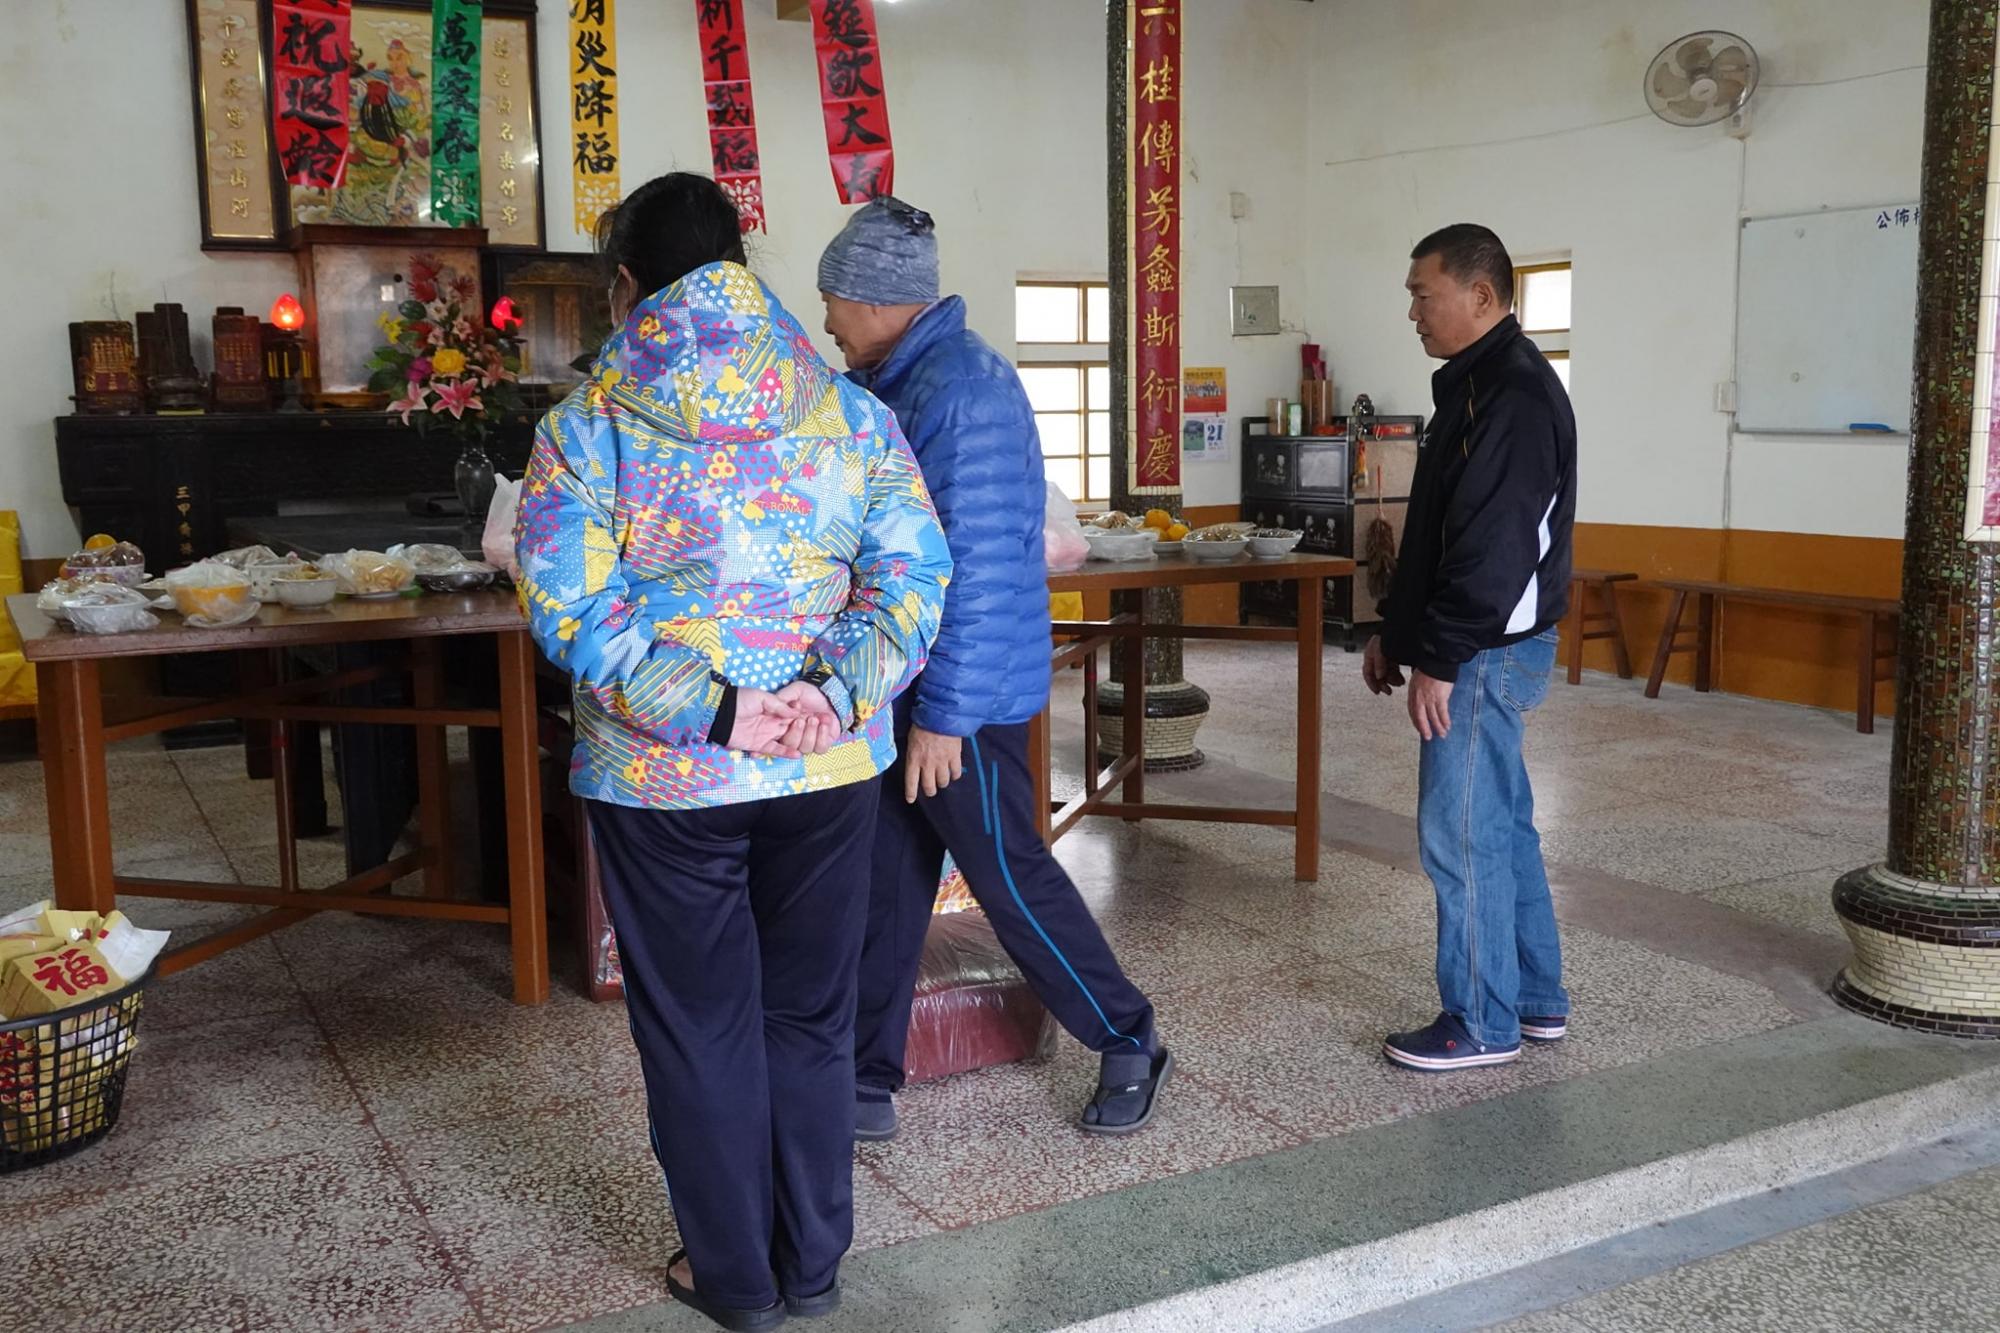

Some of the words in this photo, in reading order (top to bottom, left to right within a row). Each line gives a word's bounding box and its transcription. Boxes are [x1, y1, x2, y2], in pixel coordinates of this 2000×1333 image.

[1876, 207, 1920, 230] 公佈
[1207, 424, 1223, 441] 21
[32, 948, 109, 996] 福
